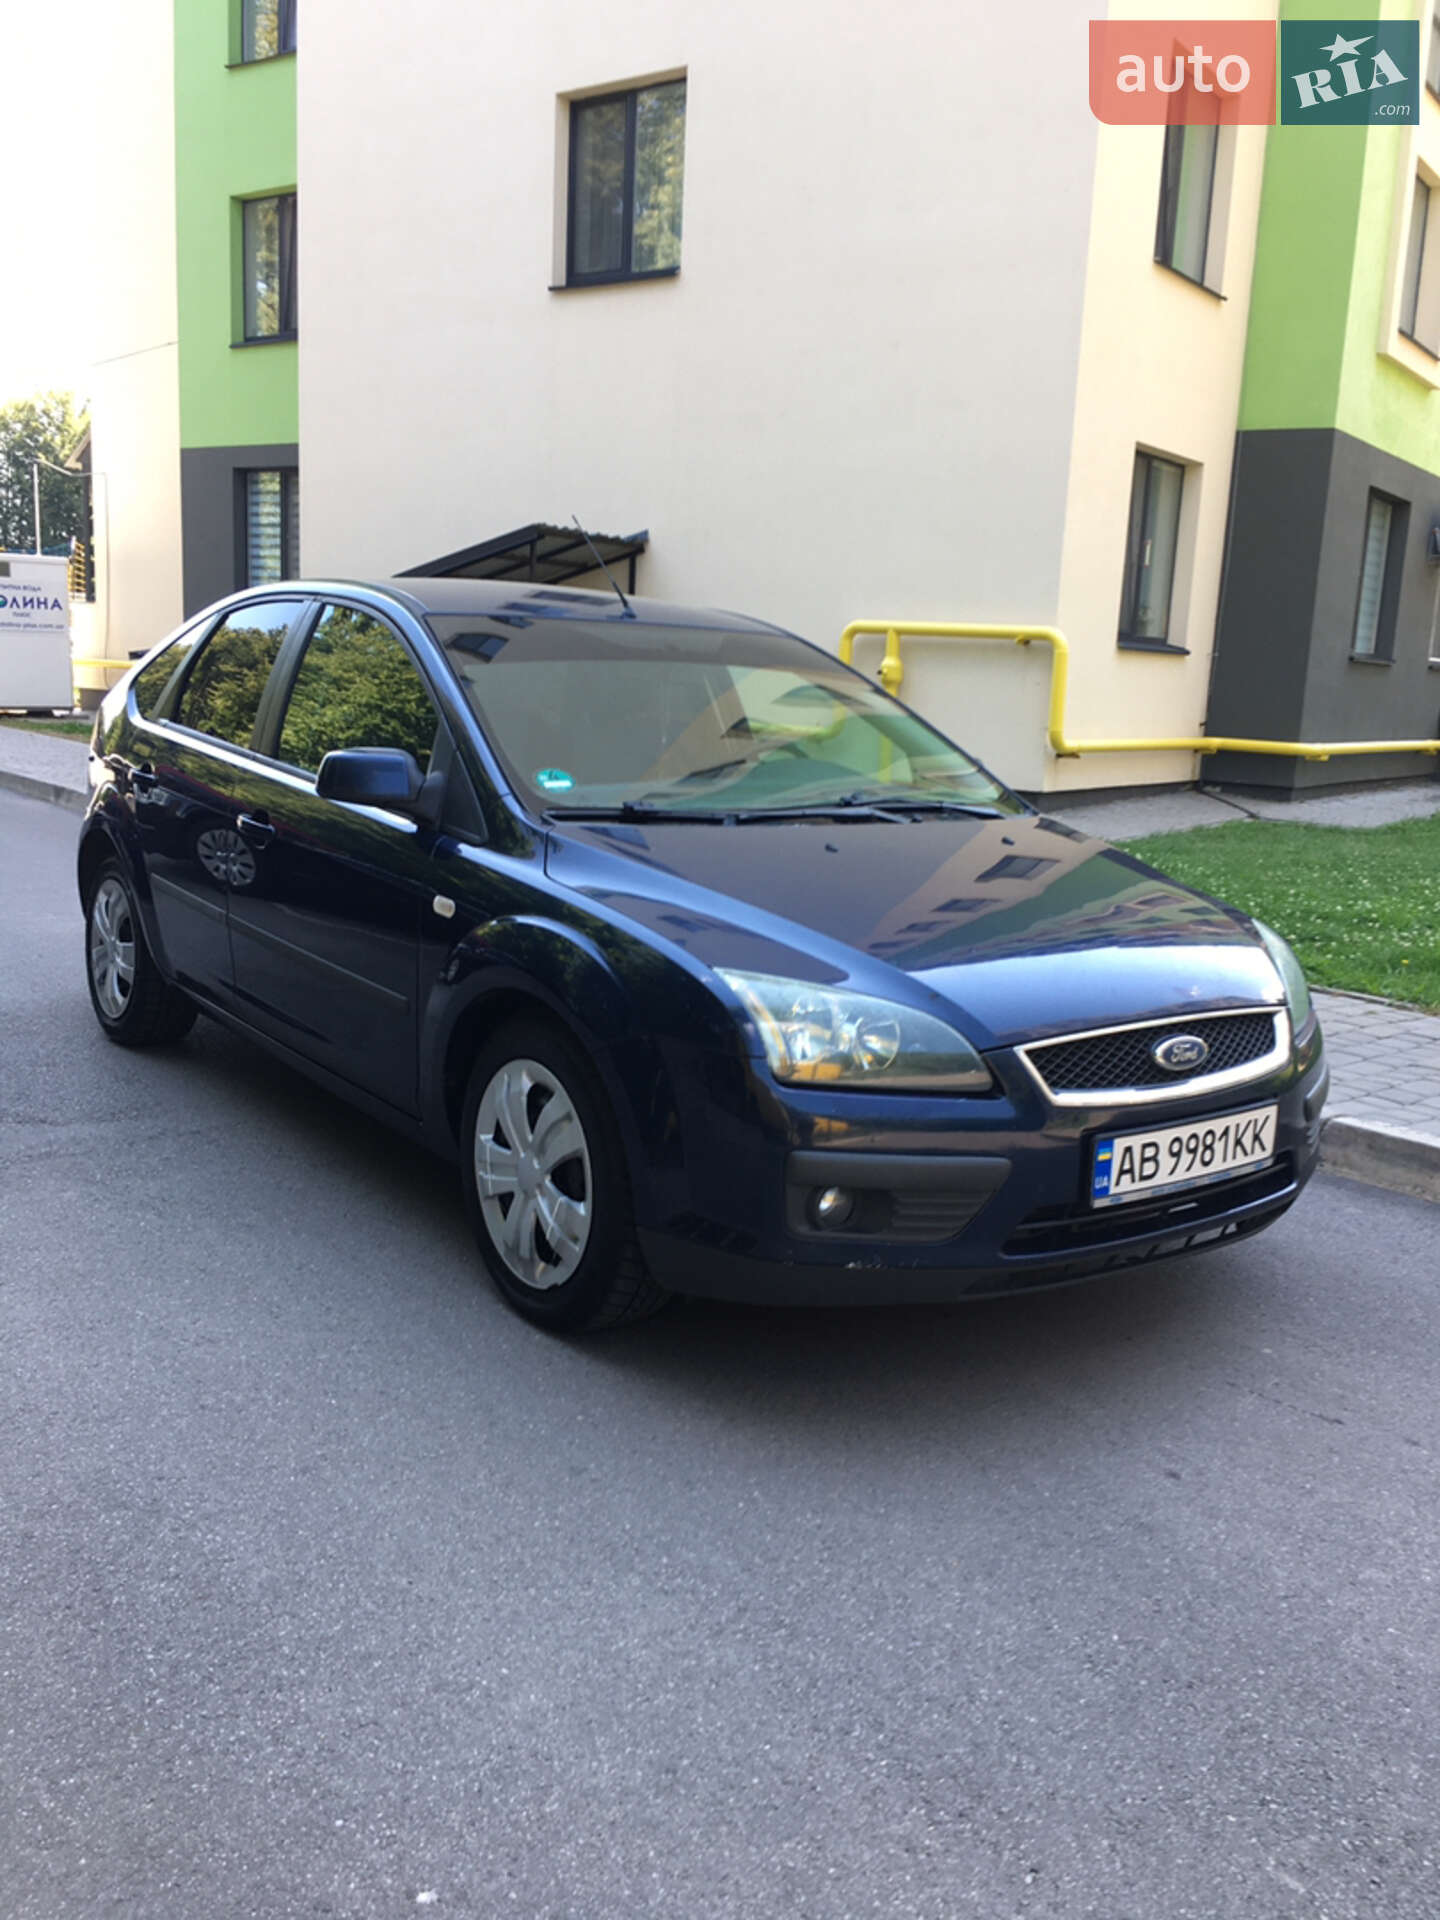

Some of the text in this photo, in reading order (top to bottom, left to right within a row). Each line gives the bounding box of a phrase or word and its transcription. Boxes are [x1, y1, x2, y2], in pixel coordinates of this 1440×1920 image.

[1170, 1043, 1199, 1063] Ford
[1115, 1141, 1160, 1187] AB
[1168, 1115, 1270, 1176] 9981KK
